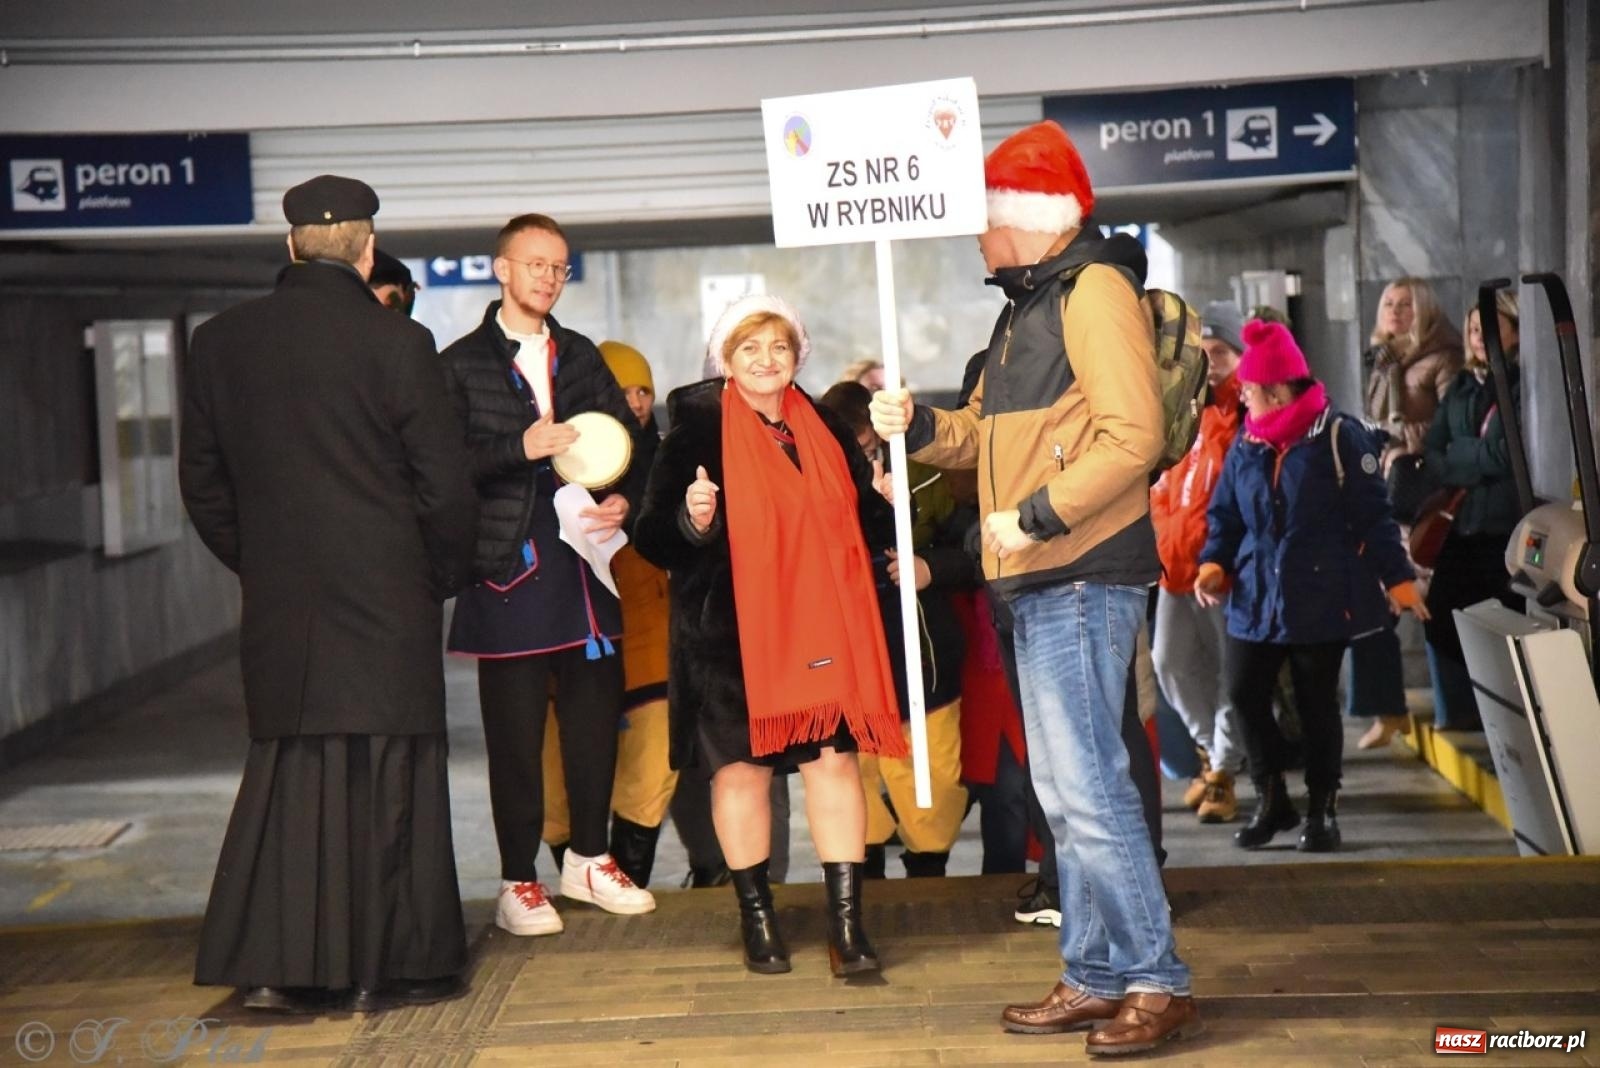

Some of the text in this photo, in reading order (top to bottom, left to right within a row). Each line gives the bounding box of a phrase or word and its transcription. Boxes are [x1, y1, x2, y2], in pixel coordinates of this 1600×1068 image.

[1100, 110, 1215, 150] peron 1
[827, 154, 920, 188] ZS NR 6
[1164, 149, 1215, 165] platform
[75, 157, 195, 193] peron 1
[78, 194, 132, 210] platform
[807, 193, 946, 228] W RYBNIKU
